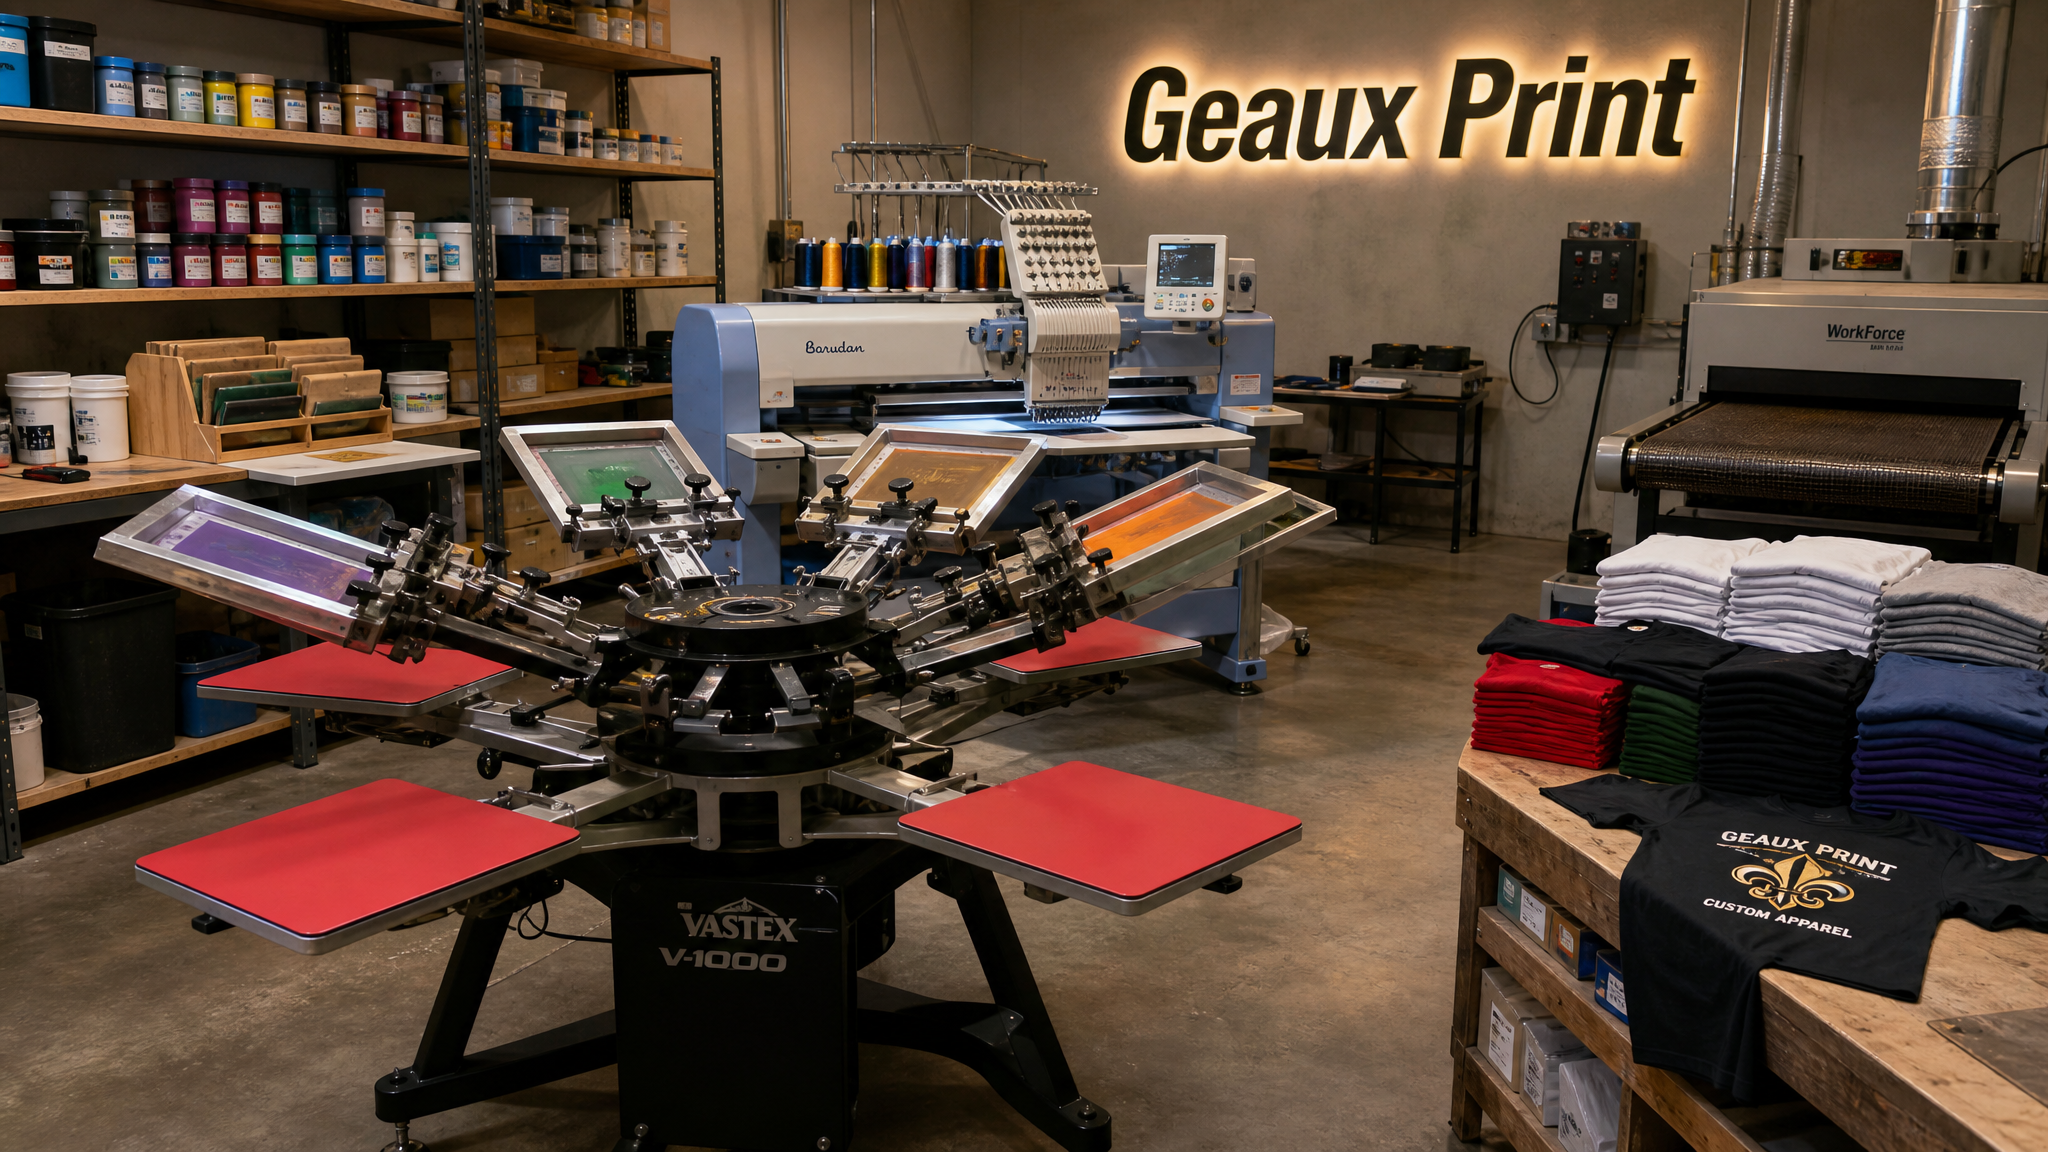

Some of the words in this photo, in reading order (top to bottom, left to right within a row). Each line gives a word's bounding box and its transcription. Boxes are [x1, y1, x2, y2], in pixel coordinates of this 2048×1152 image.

[1124, 66, 1418, 162] Geaux
[1438, 56, 1696, 159] Print
[1827, 323, 1905, 340] WorkForce
[805, 340, 865, 354] Barudan
[1721, 830, 1809, 852] GEAUX
[1815, 843, 1898, 875] PRINT
[680, 912, 798, 942] VASTEX
[1703, 898, 1771, 920] CUSTOM
[1774, 914, 1852, 938] APPAREL
[659, 947, 787, 972] V-1000
